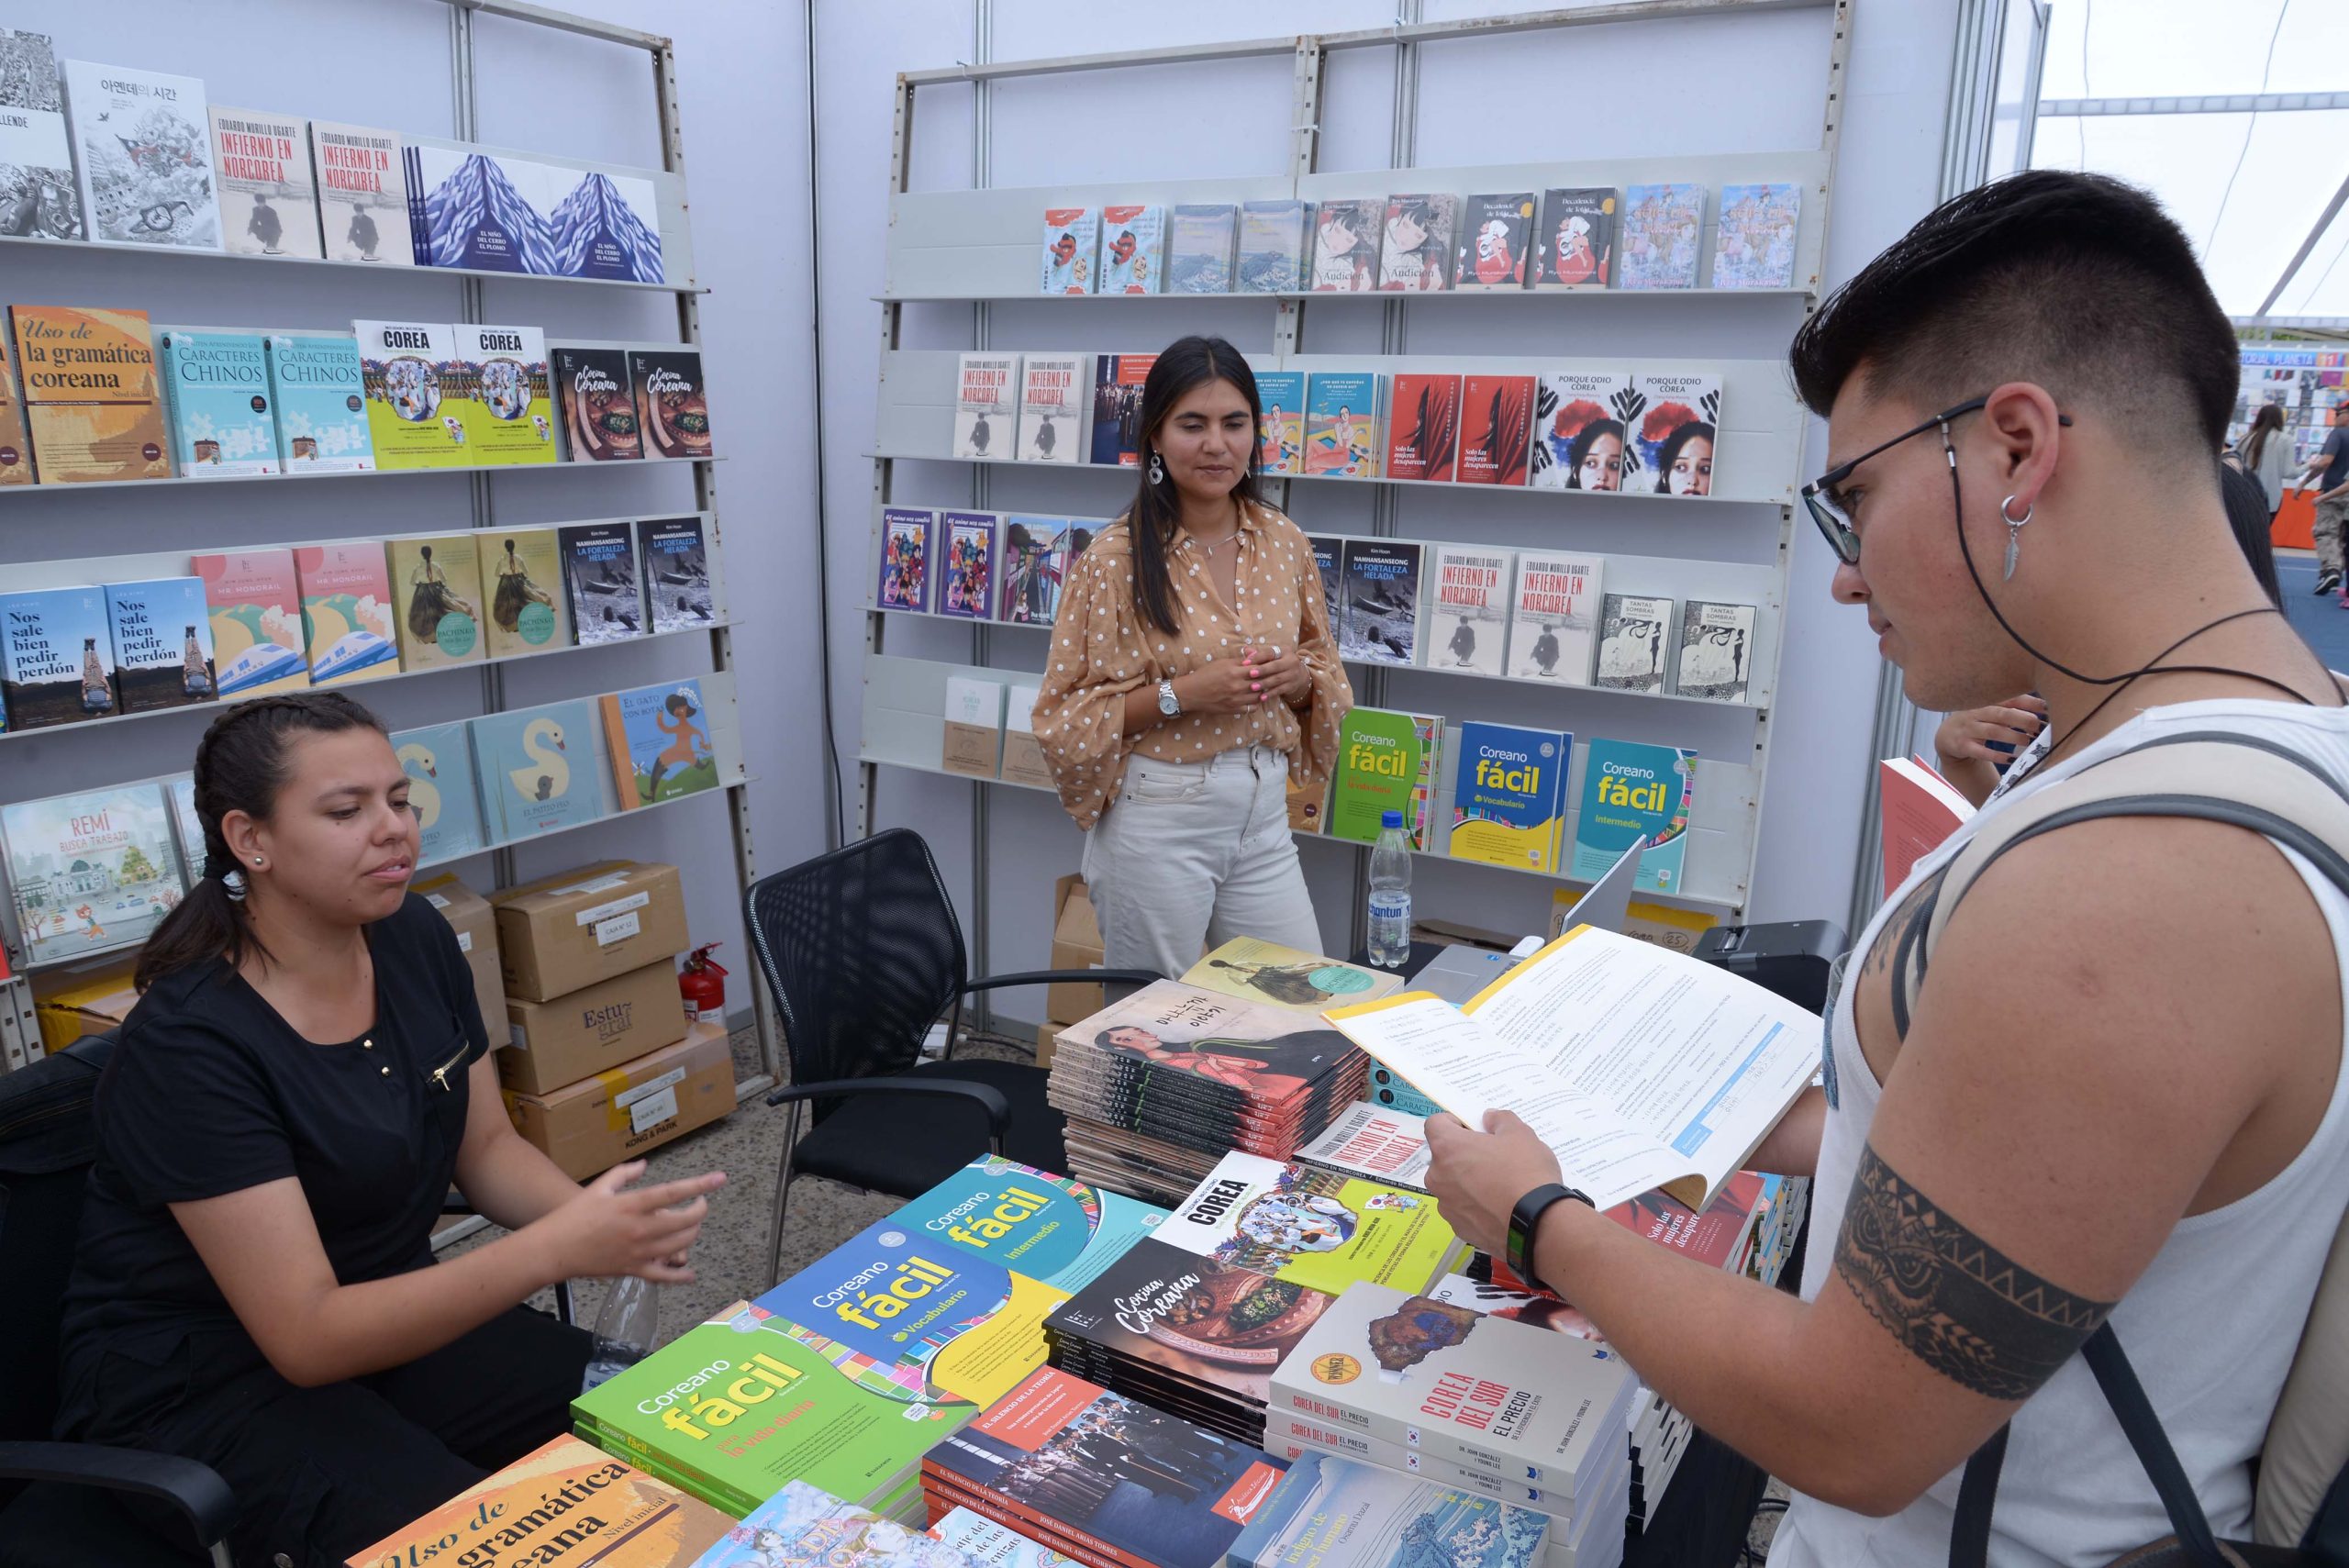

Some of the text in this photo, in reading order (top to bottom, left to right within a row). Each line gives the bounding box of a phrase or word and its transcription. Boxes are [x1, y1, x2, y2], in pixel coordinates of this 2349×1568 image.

[153, 87, 176, 101] 시간
[0, 115, 28, 128] LENDE
[218, 118, 296, 138] EDUARDO MURILLO UGARTE
[221, 132, 293, 160] INFIERNO EN
[323, 145, 388, 171] INFIERNO EN
[224, 157, 284, 182] NORCOREA
[326, 168, 382, 192] NORCOREA
[23, 319, 92, 339] Uso de
[384, 331, 430, 349] COREA
[480, 335, 522, 350] COREA
[28, 341, 150, 367] la gramática
[179, 348, 260, 361] CARACTERES
[279, 350, 356, 363] CARACTERES
[30, 370, 120, 387] coreana
[182, 362, 262, 382] CHINOS
[282, 363, 358, 382] CHINOS
[964, 371, 1006, 385] INFIERNO EN
[1030, 372, 1070, 387] INFIERNO EN
[1559, 375, 1588, 384] PORQUE
[1647, 377, 1677, 385] PORQUE
[574, 371, 618, 393] Coreana
[647, 373, 692, 395] Coreana
[963, 387, 998, 404] NORCOREA
[1028, 389, 1063, 406] NORCOREA
[576, 538, 624, 547] NAMHANSANSEONG
[664, 546, 689, 554] HELADA
[589, 553, 617, 562] HELADA
[1354, 556, 1408, 565] NAMHANSANSEONG
[1444, 555, 1503, 569] EDUARDO MURILLO UGARTE
[1364, 564, 1408, 574] FORTALEZA
[1364, 572, 1395, 581] HELADA
[1442, 565, 1497, 587] INFIERNO EN
[1526, 562, 1589, 575] EDUARDO MURILLO UGARTE
[1525, 573, 1582, 595] INFIERNO EN
[1442, 587, 1486, 606] NORCOREA
[1523, 593, 1571, 615] NORCOREA
[117, 601, 145, 612] Nos
[8, 612, 39, 624] Nos
[119, 613, 148, 625] sale
[12, 625, 43, 638] sale
[121, 626, 153, 638] bien
[14, 639, 49, 651] bien
[124, 637, 161, 653] pedir
[17, 651, 58, 668] pedir
[126, 650, 176, 666] perdón
[18, 662, 74, 682] perdón
[1353, 731, 1396, 747] Coreano
[1350, 744, 1407, 777] fácil
[1479, 746, 1527, 762] Coreano
[1476, 760, 1540, 794] fácil
[1603, 762, 1653, 779] Coreano
[1483, 795, 1525, 809] Vocabulario
[1598, 776, 1666, 812] fácil
[1596, 815, 1642, 828] Intermedio
[60, 839, 87, 852] BUSCA
[626, 1133, 648, 1149] KONG
[656, 1122, 677, 1135] PARK
[1364, 1135, 1424, 1173] NORCOREA
[926, 1192, 990, 1231] Coreano
[1187, 1180, 1249, 1225] COREA
[949, 1187, 1049, 1249] fácil
[1663, 1215, 1685, 1244] mujeres
[1006, 1221, 1060, 1260] Intermedio
[812, 1261, 888, 1308] Coreano
[836, 1256, 954, 1330] fácil
[1115, 1278, 1164, 1315] Cocina
[1116, 1273, 1200, 1334] Coreana
[904, 1288, 967, 1334] Vocabulario
[638, 1358, 730, 1417] Coreano
[662, 1352, 804, 1440] fácil
[1420, 1372, 1475, 1418] COREA
[982, 1369, 1055, 1429] EL SILENCIO DE LA TEORÍA
[1454, 1380, 1509, 1430] DEL SUR
[1582, 1397, 1591, 1406] LEE
[1294, 1396, 1312, 1412] COREA
[1315, 1402, 1325, 1416] DEL
[1327, 1405, 1339, 1419] SUR
[1349, 1412, 1369, 1424] PRECIO
[1493, 1391, 1531, 1438] EL PRECIO
[457, 1460, 630, 1568] gramática
[1338, 1502, 1371, 1544] Osamu Dazai
[1040, 1516, 1118, 1557] JOSÉ DANIEL ARIAS TORRES
